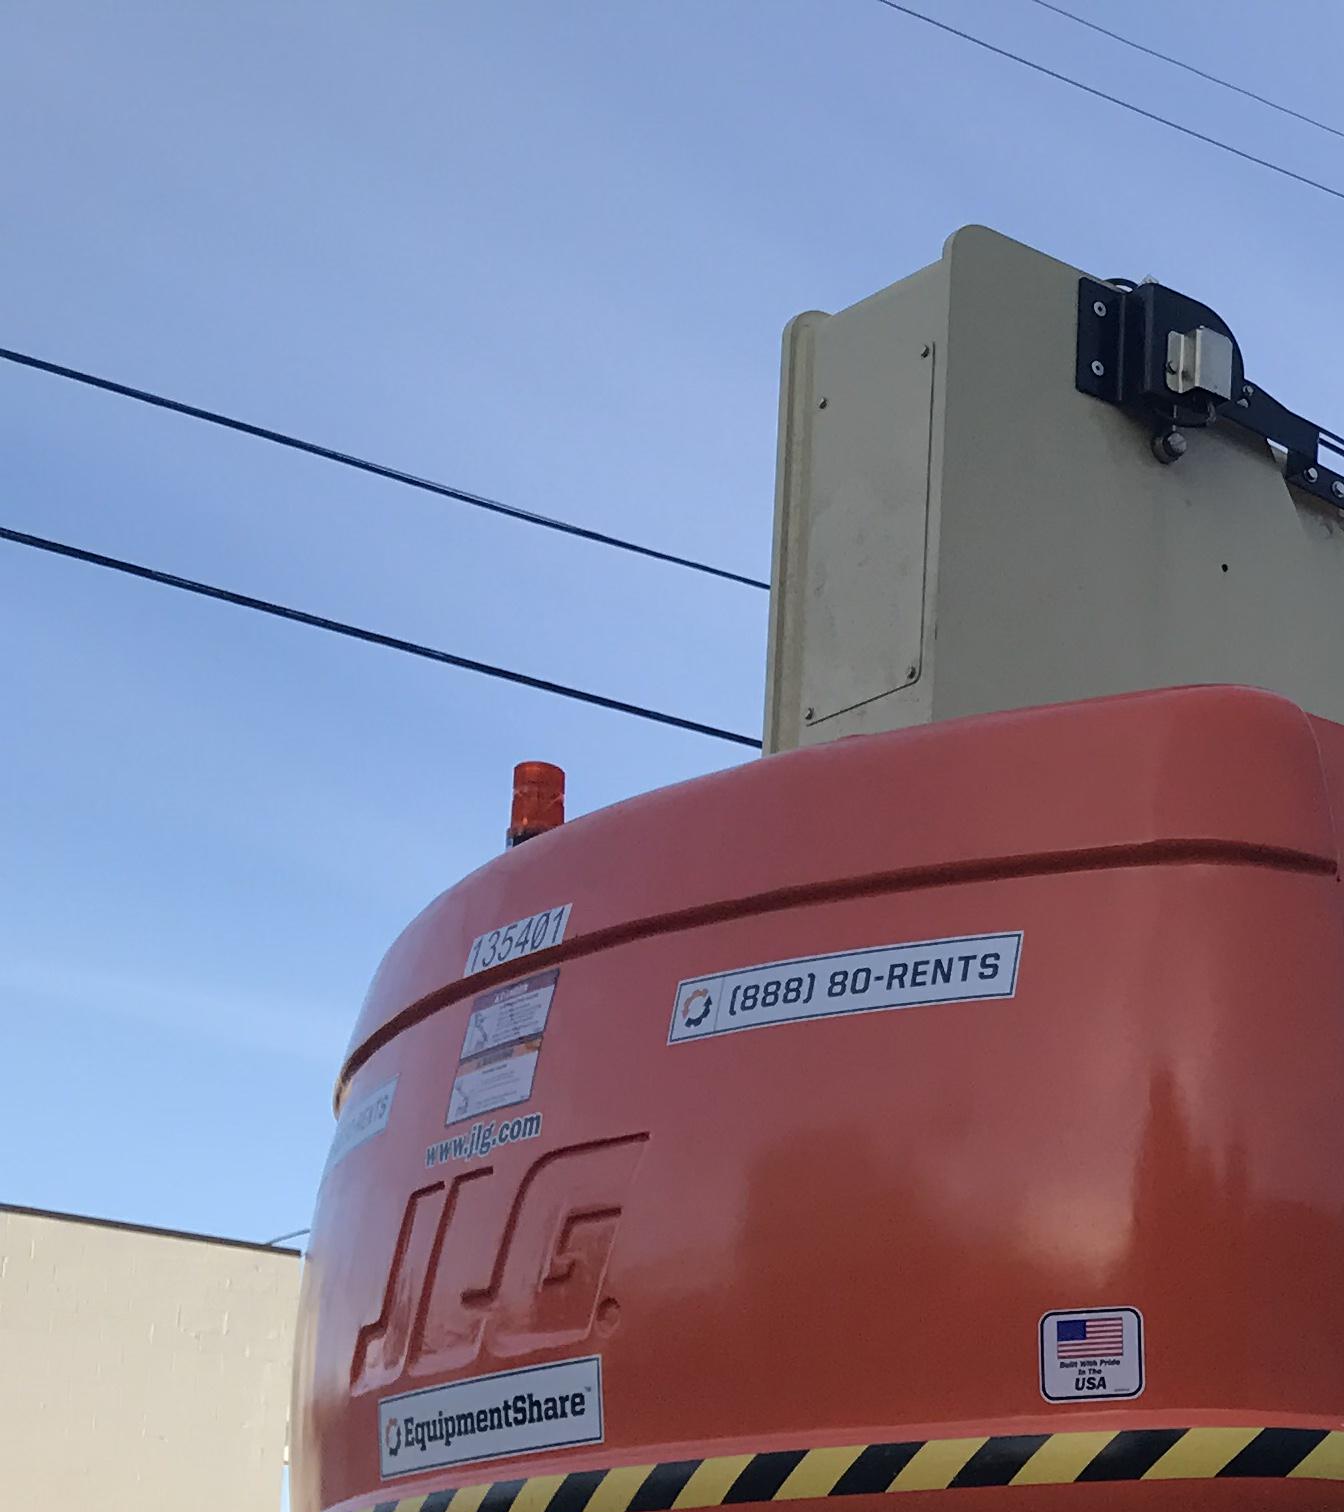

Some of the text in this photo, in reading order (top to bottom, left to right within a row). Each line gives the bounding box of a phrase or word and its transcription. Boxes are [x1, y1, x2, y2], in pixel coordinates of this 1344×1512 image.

[470, 905, 566, 973] 135401
[728, 951, 1001, 1017] (888) 80-RENTS
[425, 1113, 542, 1166] www.jlg.com
[350, 1131, 650, 1397] JLG
[1060, 1360, 1077, 1369] Built
[1100, 1358, 1121, 1367] Pride
[1074, 1376, 1107, 1392] USA
[404, 1391, 587, 1451] EquipmentShare
